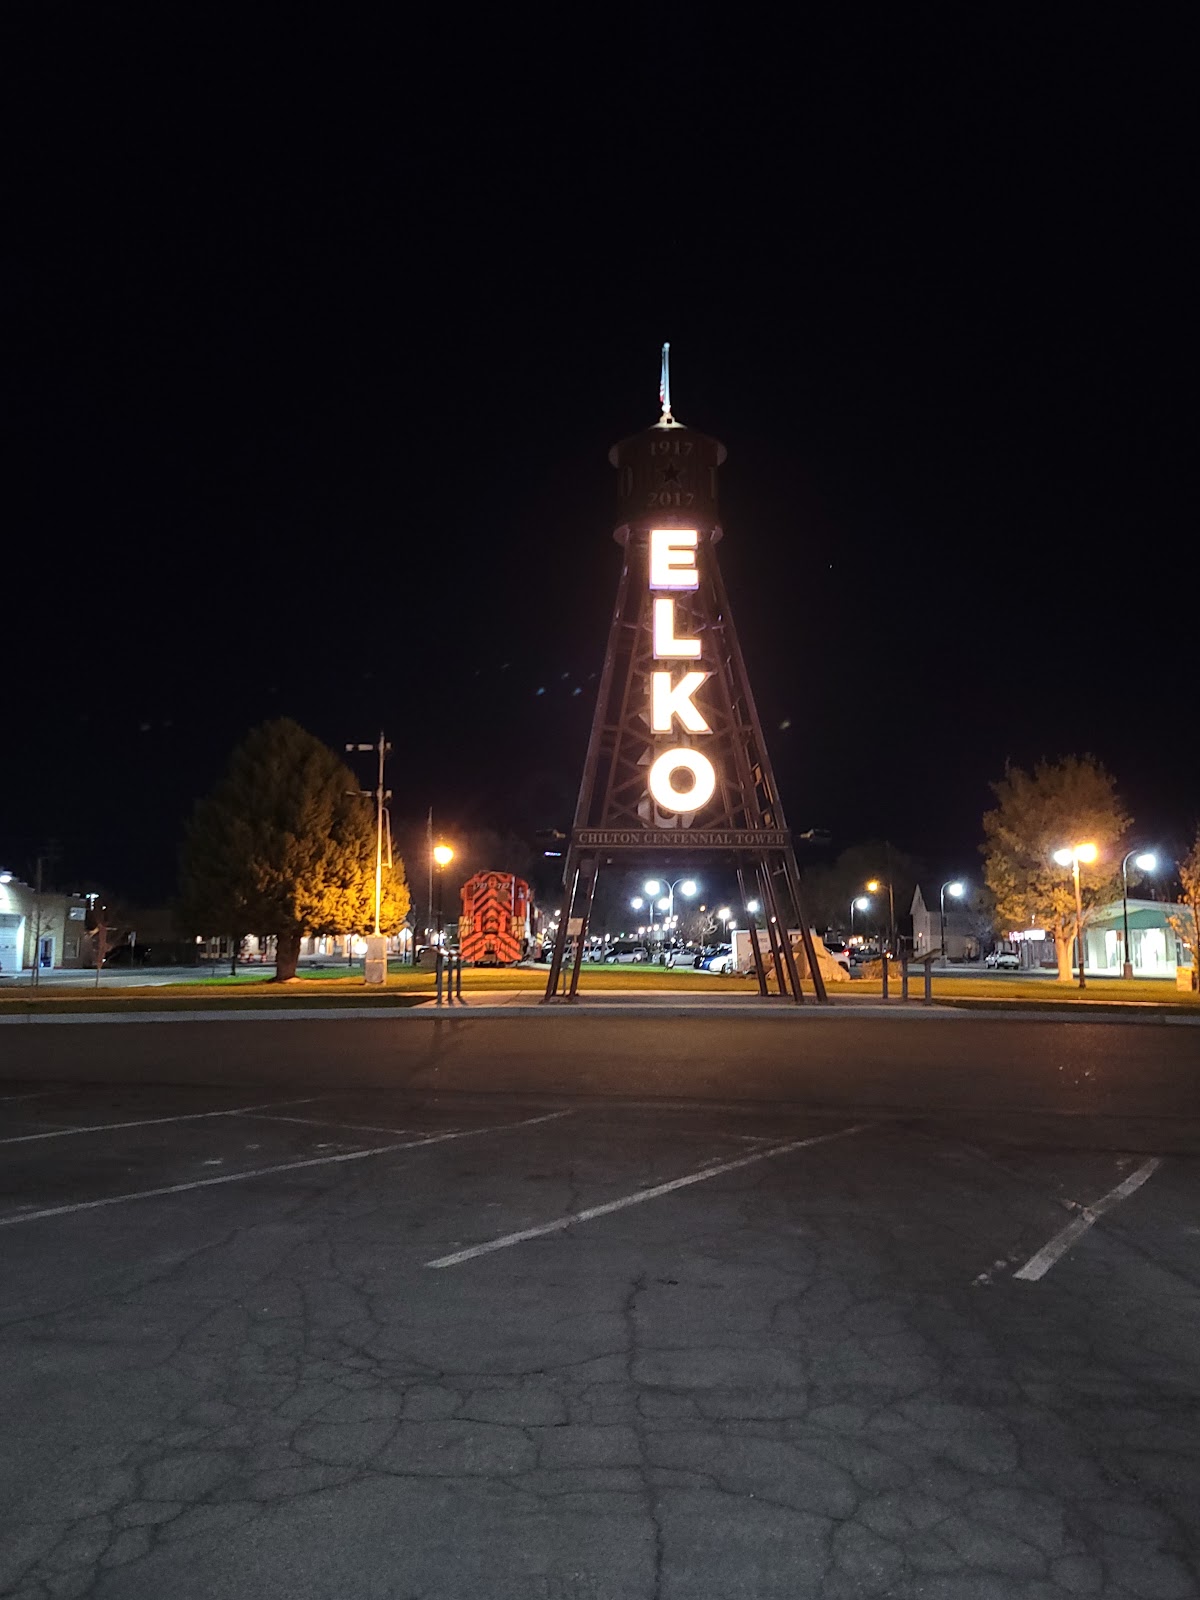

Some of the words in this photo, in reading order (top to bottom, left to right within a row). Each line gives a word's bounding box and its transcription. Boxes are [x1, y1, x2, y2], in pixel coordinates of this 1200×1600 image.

[649, 440, 694, 456] 1917
[648, 491, 694, 507] 2017
[649, 528, 716, 813] ELKO
[578, 832, 640, 844] CHILTON
[643, 832, 732, 844] CENTENNIAL
[736, 833, 785, 844] TOWER
